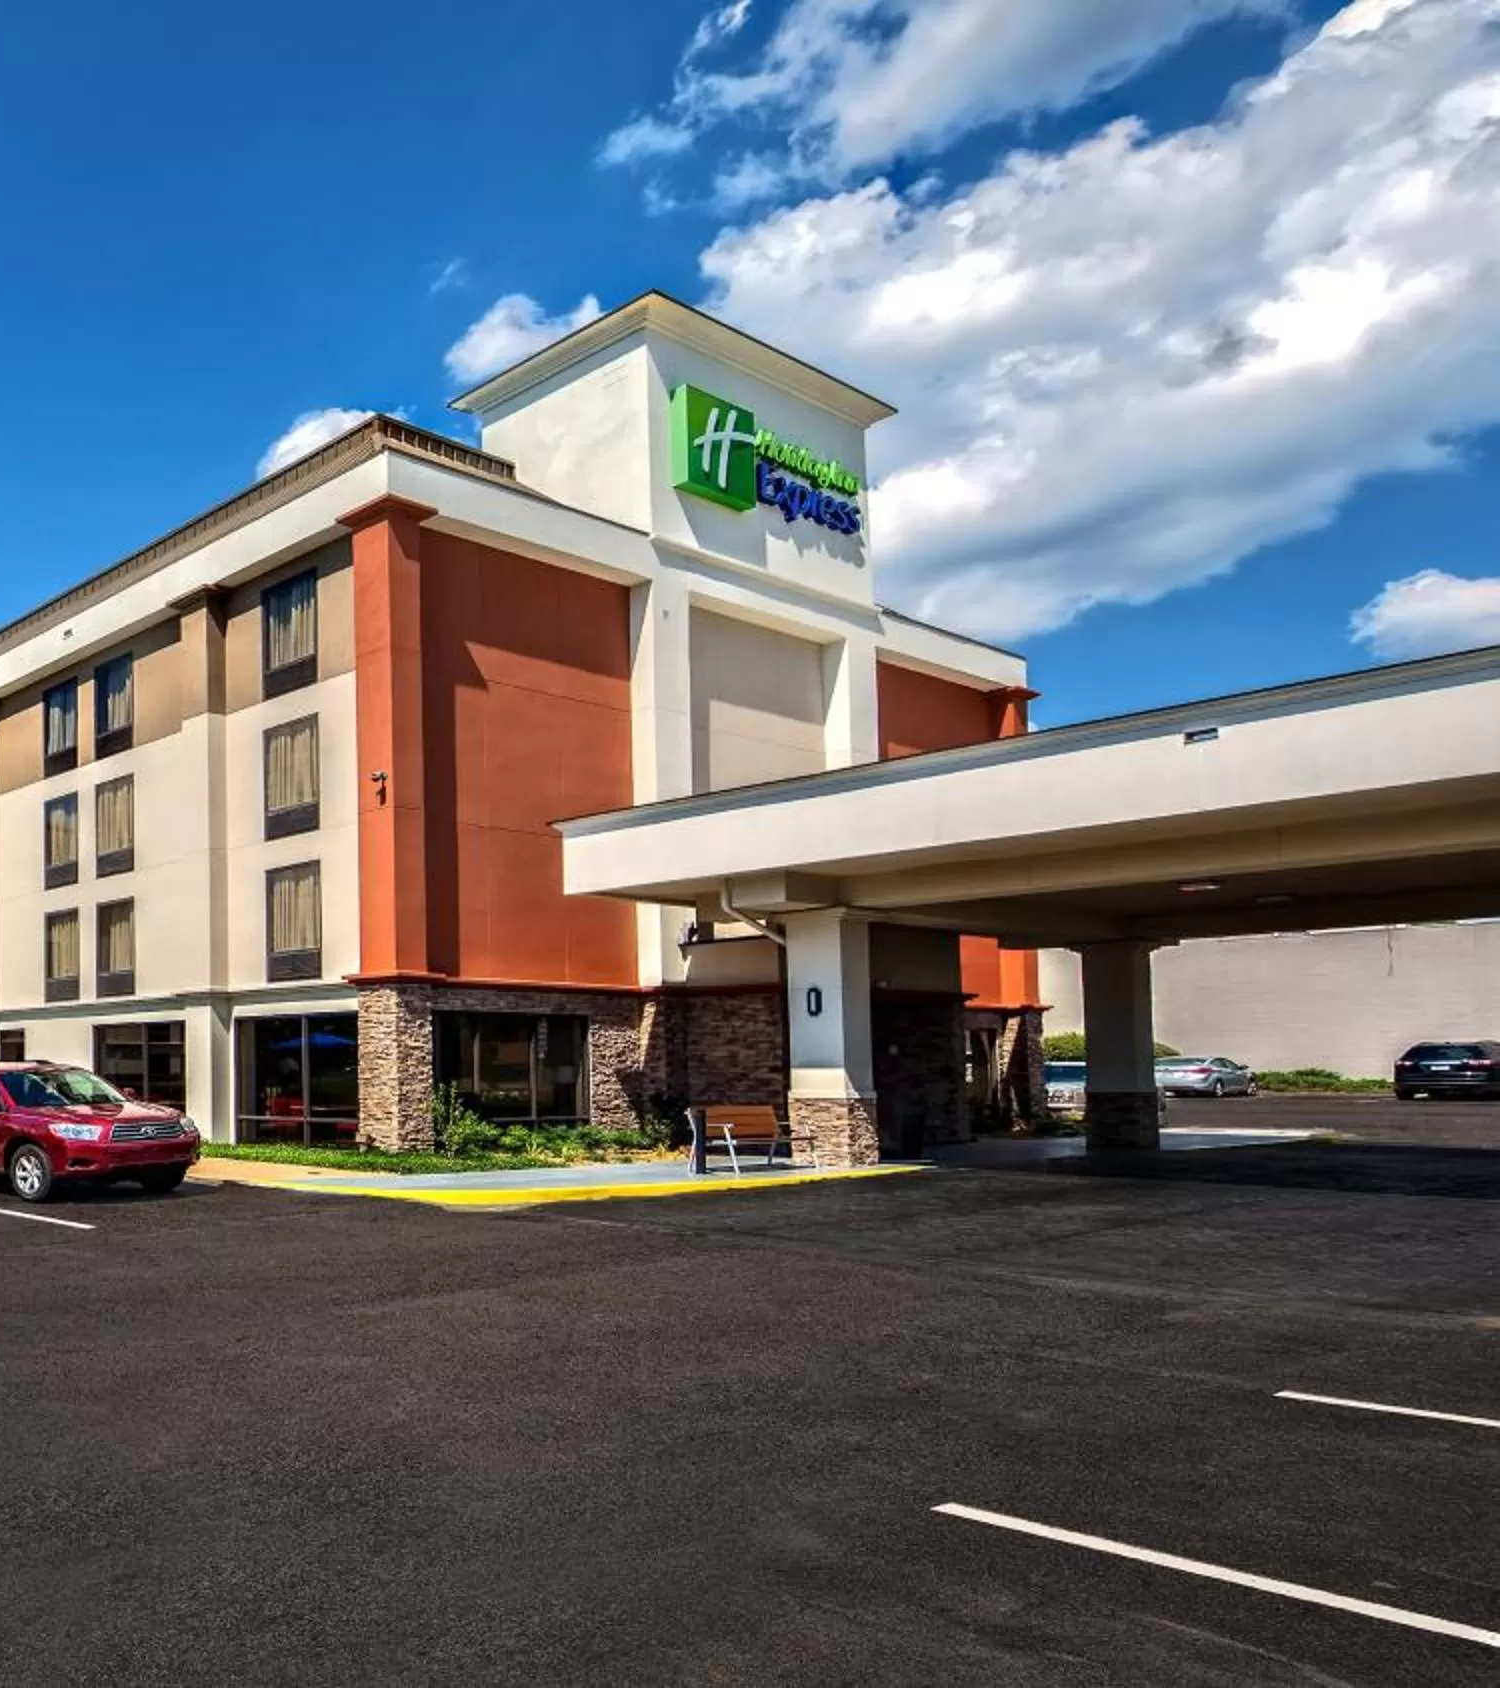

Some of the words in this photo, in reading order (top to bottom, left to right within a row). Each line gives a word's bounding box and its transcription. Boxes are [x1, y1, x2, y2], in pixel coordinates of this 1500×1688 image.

[693, 407, 755, 489] H
[755, 430, 829, 489] Holiday
[829, 460, 858, 494] Inn
[756, 460, 860, 534] Express
